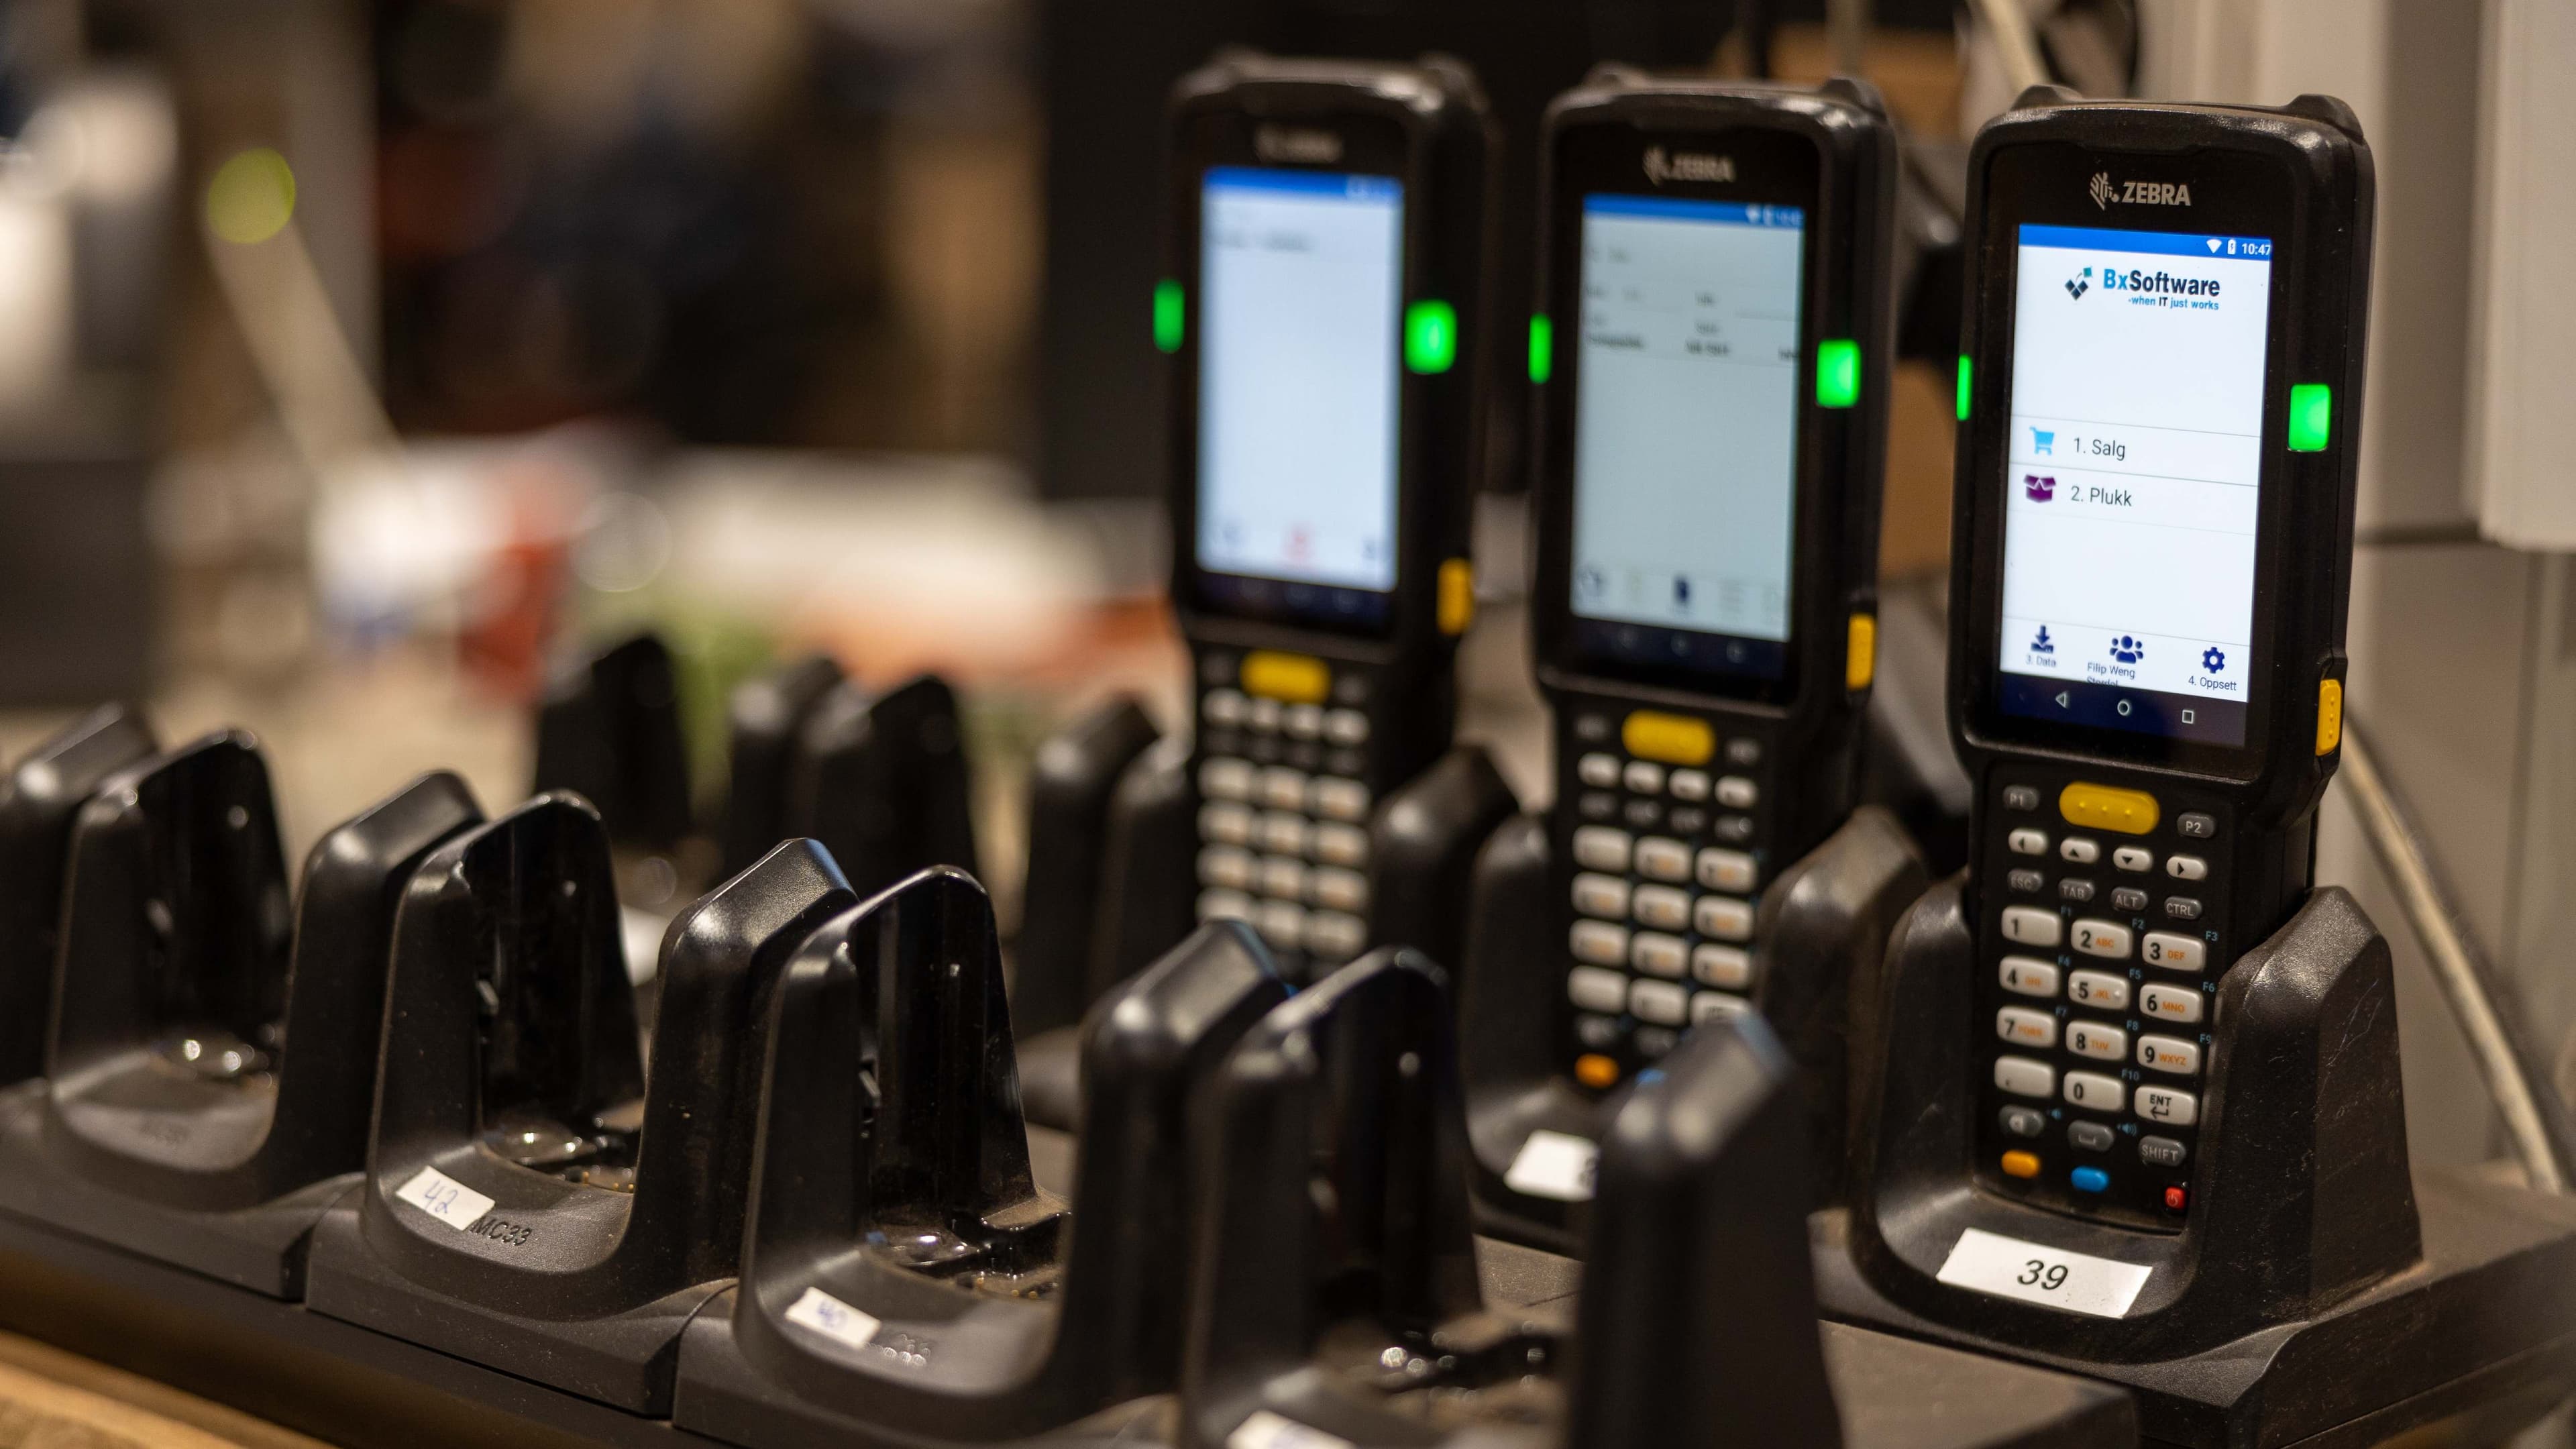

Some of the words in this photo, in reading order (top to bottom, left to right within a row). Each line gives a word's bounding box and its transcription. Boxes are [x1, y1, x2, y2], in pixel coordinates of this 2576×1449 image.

[2121, 181, 2191, 207] ZEBRA
[2242, 242, 2271, 256] 10:47
[2103, 268, 2220, 297] BxSoftware
[2158, 297, 2168, 307] IT
[2170, 298, 2188, 309] just
[2190, 300, 2219, 311] works
[2074, 437, 2086, 454] 1.
[2092, 439, 2126, 462] Salg
[2071, 485, 2084, 502] 2.
[2089, 488, 2133, 508] Plukk
[2035, 655, 2057, 668] Data
[2087, 661, 2107, 676] Filip
[2109, 664, 2136, 680] Weng
[2188, 676, 2198, 686] 4.
[2200, 677, 2237, 692] Oppsett
[2186, 821, 2202, 834] P2
[2062, 885, 2085, 898] TAB
[2115, 894, 2139, 908] ALT
[2166, 903, 2194, 917] CTRL
[2011, 918, 2019, 936] 1
[2132, 918, 2145, 930] F2
[2080, 930, 2092, 949] 2
[2205, 930, 2218, 941] F3
[2149, 942, 2161, 960] 3
[2167, 950, 2186, 960] DEF
[2007, 969, 2017, 985] 4
[2129, 968, 2141, 980] F5
[2078, 981, 2089, 1000] 5
[2202, 981, 2214, 993] F6
[2147, 994, 2158, 1012] 6
[2162, 1001, 2186, 1013] MNO
[2004, 1017, 2015, 1036] 7
[2126, 1020, 2139, 1031] F8
[2076, 1032, 2086, 1051] 8
[2091, 1039, 2110, 1051] TUV
[2200, 1034, 2212, 1044] F9
[2144, 1046, 2155, 1064] 9
[2159, 1054, 2187, 1067] WXYZ
[2121, 1069, 2140, 1081] F10
[2074, 1082, 2084, 1100] 0
[2149, 1093, 2172, 1107] ENT
[2141, 1144, 2180, 1162] SHIFT
[424, 1180, 459, 1215] 42
[470, 1216, 533, 1246] MC33
[2017, 1259, 2069, 1291] 39
